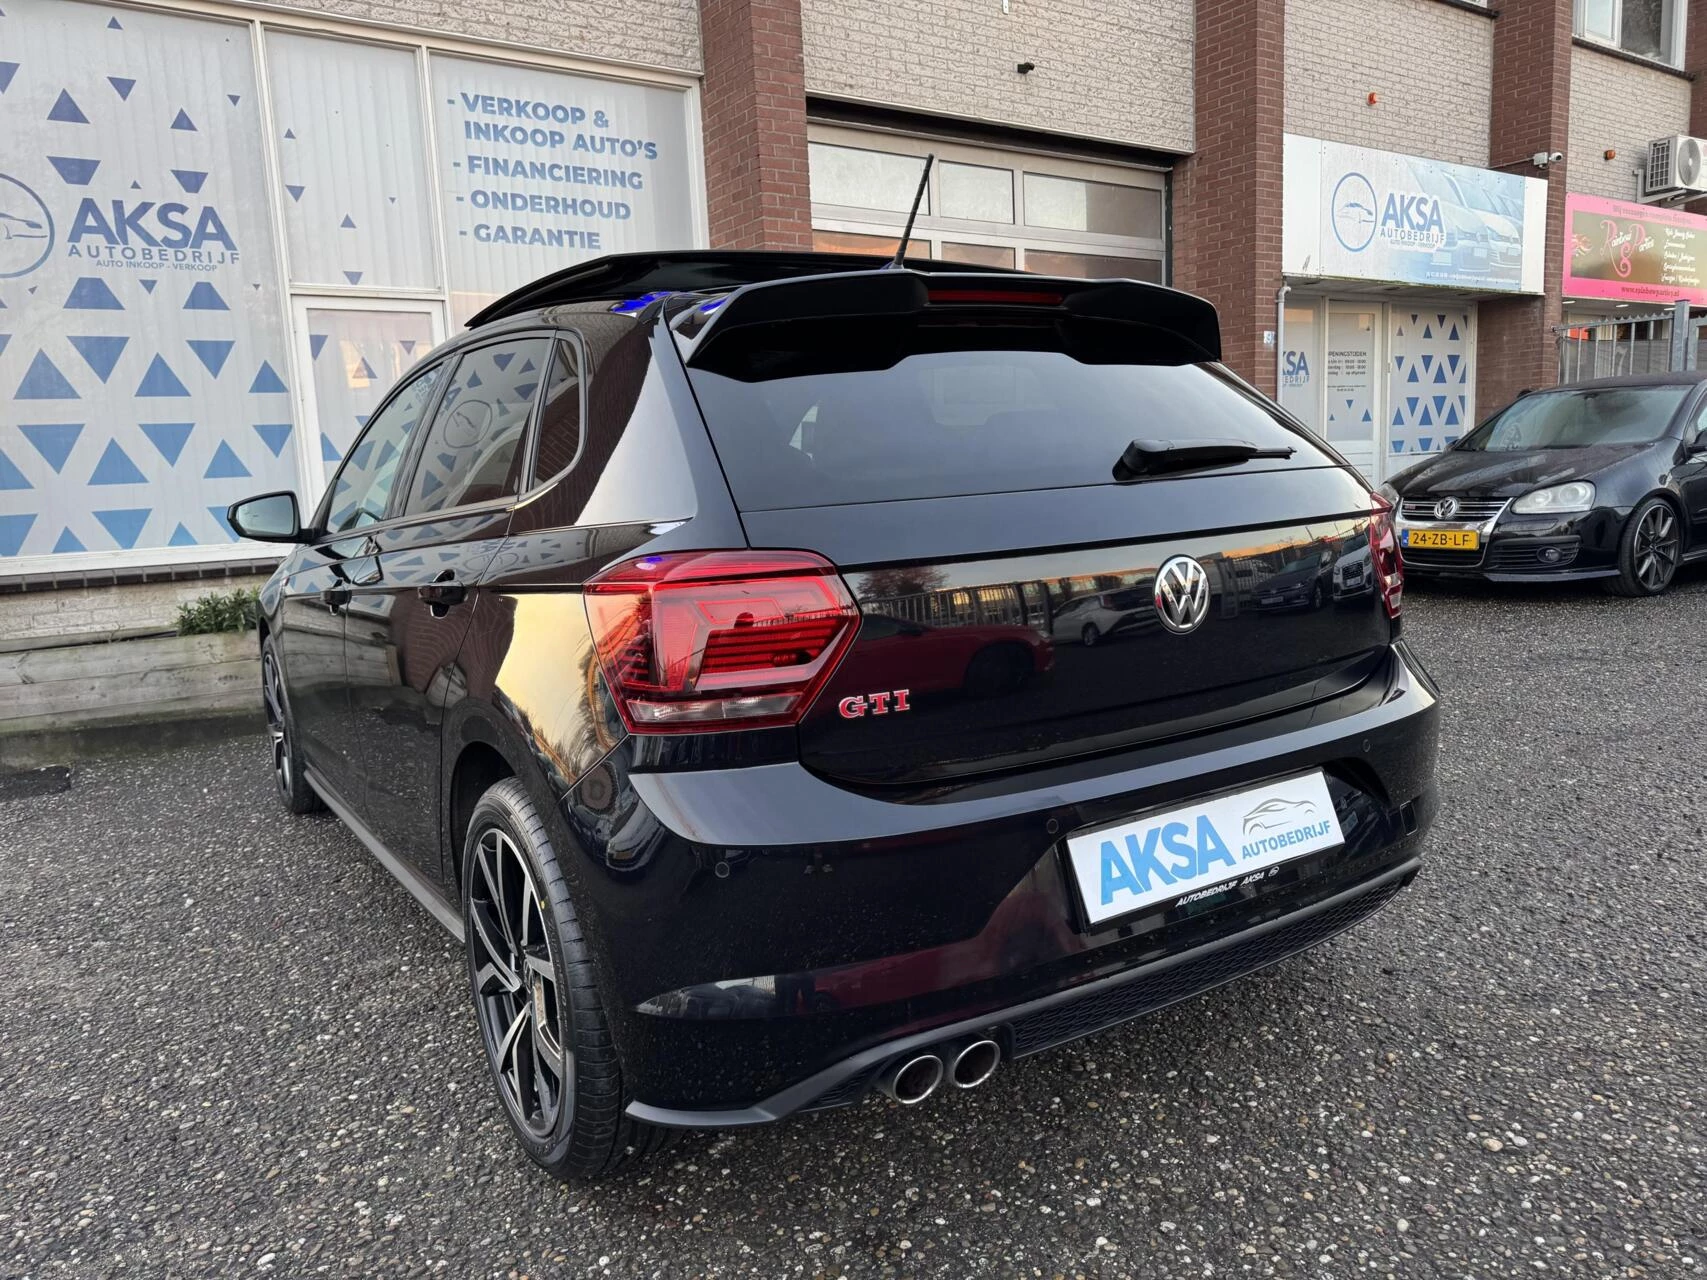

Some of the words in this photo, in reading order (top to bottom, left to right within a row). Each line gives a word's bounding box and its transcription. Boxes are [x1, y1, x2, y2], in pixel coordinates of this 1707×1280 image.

[460, 92, 586, 125] VERKOOP
[593, 110, 609, 129] &
[464, 120, 565, 149] INKOOP
[467, 155, 643, 190] FINANCIERING
[470, 189, 631, 220] ONDERHOUD
[1381, 193, 1444, 233] AKSA
[67, 197, 238, 251] AKSA
[473, 223, 601, 250] GARANTIE
[1380, 227, 1445, 244] AUTOBEDRIJF
[68, 244, 240, 265] AUTOBEDRIJF
[96, 260, 124, 268] AUTO
[126, 260, 165, 270] INKOOP
[172, 263, 218, 272] VERKOOP
[1412, 532, 1470, 546] 24-ZB-LF
[839, 689, 910, 719] GTI
[1241, 820, 1332, 860] AUTOBEDRIJF
[1100, 814, 1237, 906] AKSA
[1175, 880, 1238, 908] AUTOBEDRIJF
[1240, 871, 1265, 886] AKSA
